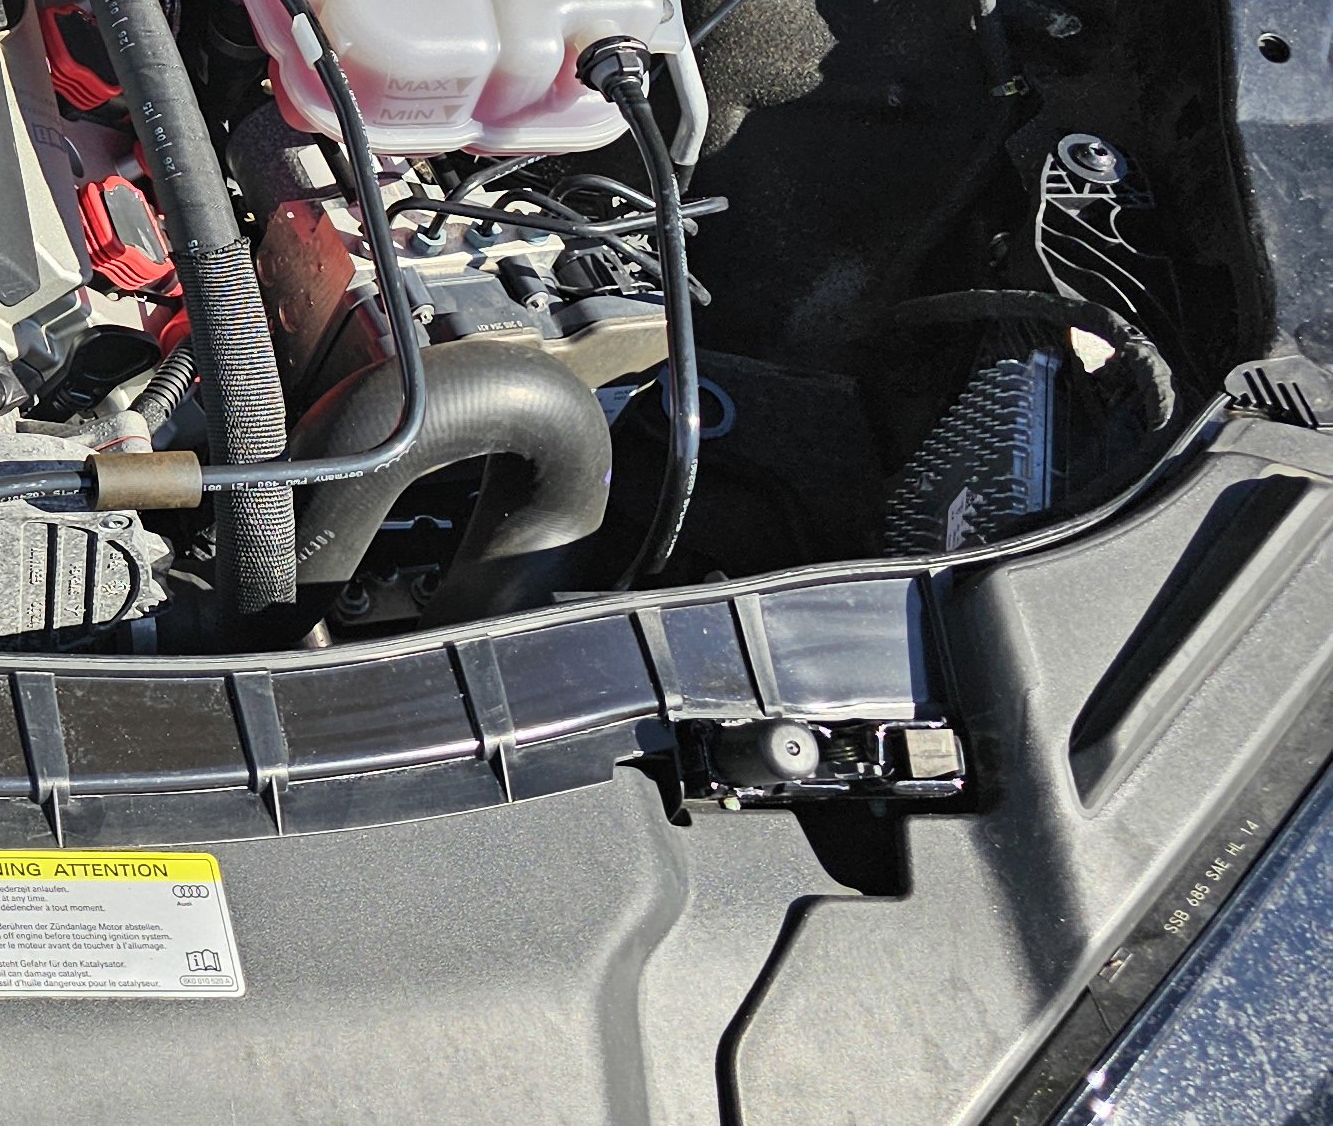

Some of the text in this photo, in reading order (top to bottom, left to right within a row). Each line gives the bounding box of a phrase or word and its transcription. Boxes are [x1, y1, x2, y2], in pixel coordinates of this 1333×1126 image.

[388, 78, 450, 91] MAX
[380, 108, 435, 121] MIN
[54, 863, 169, 877] ATTENTION
[1164, 820, 1259, 934] SSB 685 SAE HL 14
[50, 922, 96, 932] Zündanlage
[98, 923, 123, 931] Motor
[16, 933, 43, 941] engine
[44, 932, 71, 940] before
[72, 933, 107, 941] touching
[7, 941, 15, 949] le
[83, 942, 114, 950] toucher
[20, 959, 47, 968] Gefahr
[62, 960, 78, 968] den
[24, 970, 56, 979] damage
[44, 980, 86, 989] dangereux
[88, 981, 107, 989] pour
